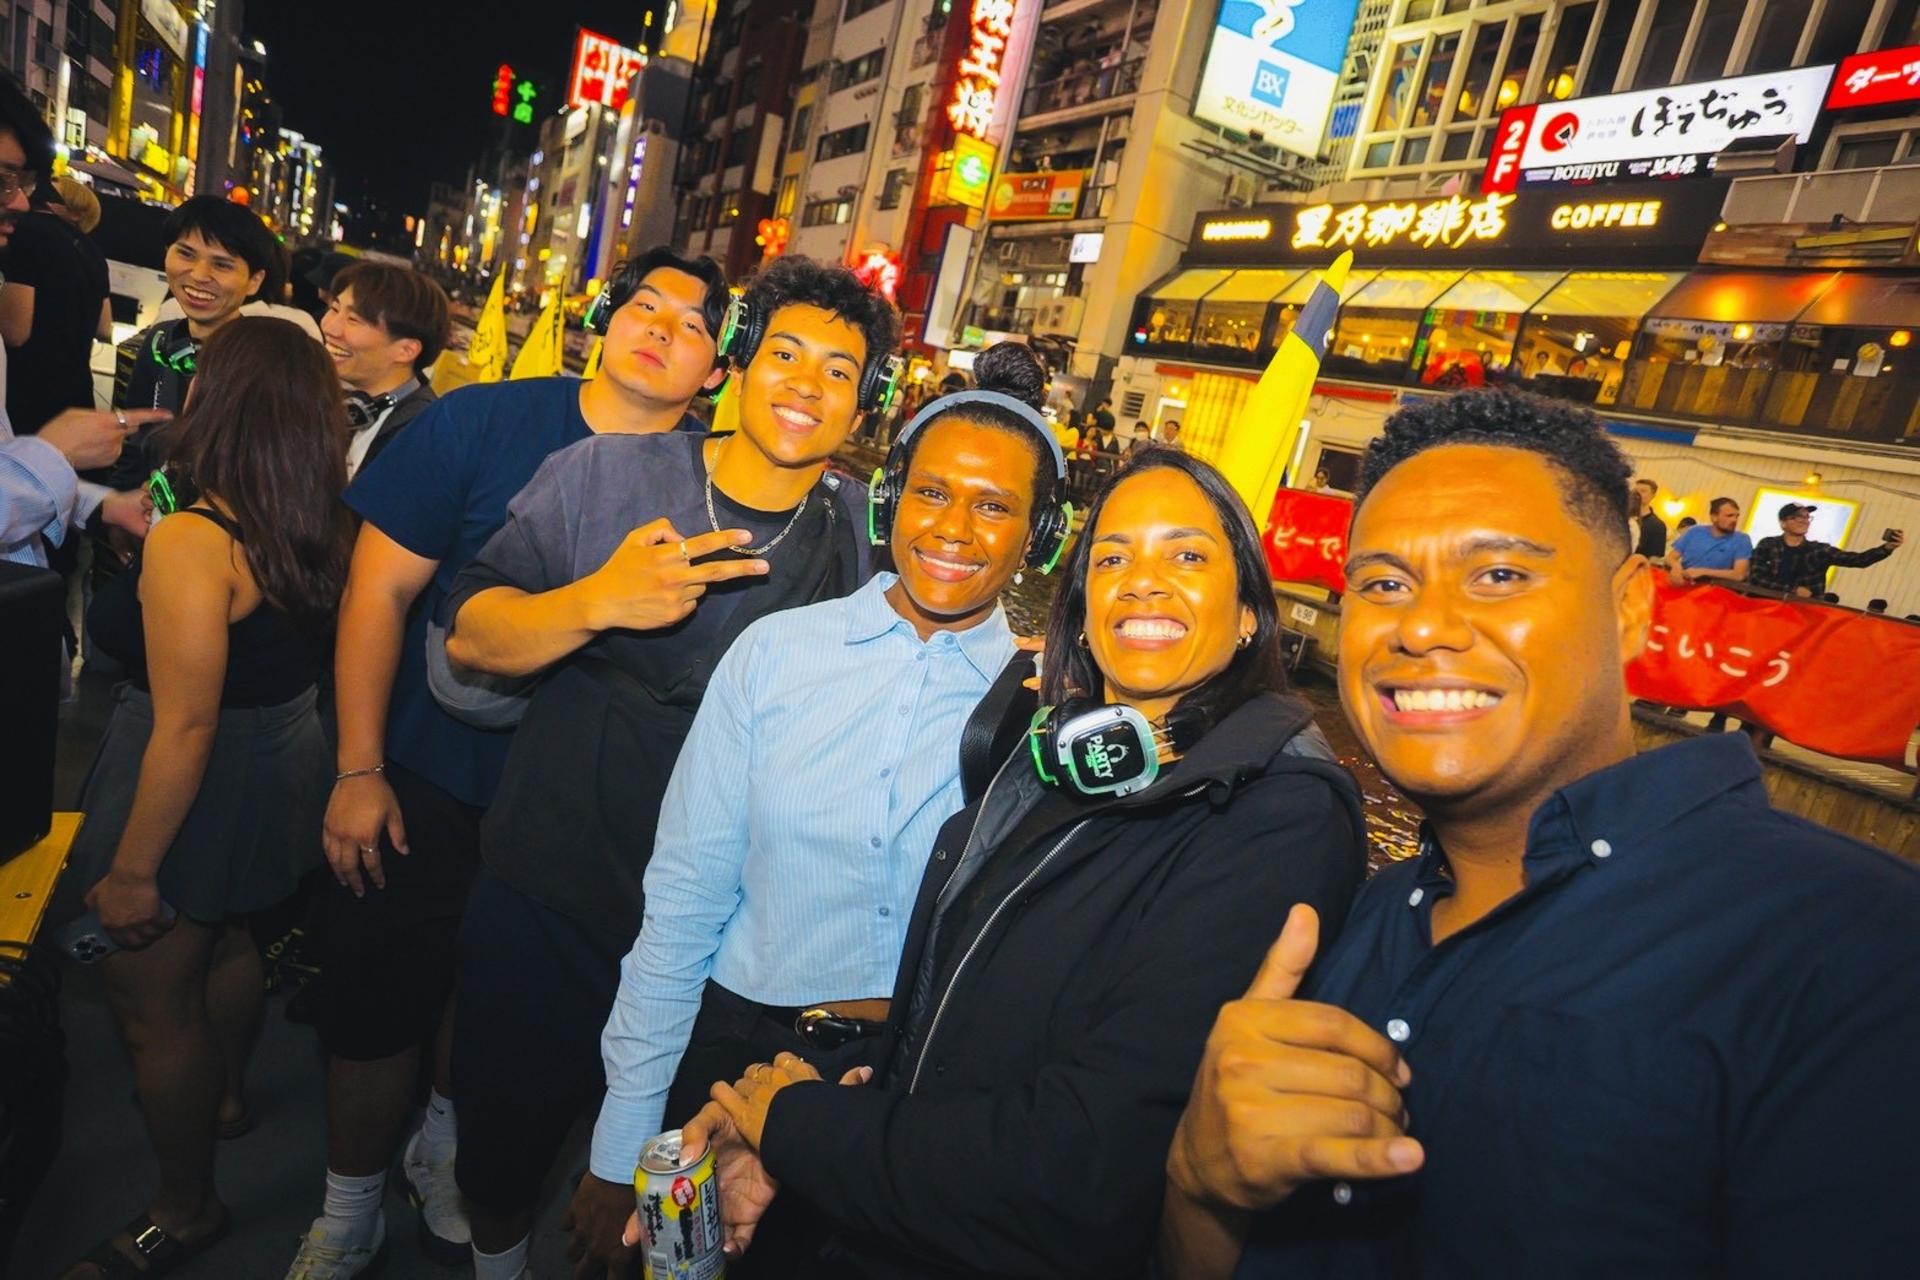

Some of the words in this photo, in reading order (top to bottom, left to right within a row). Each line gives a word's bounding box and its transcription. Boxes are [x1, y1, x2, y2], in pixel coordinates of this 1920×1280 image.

[1256, 69, 1285, 99] BX
[1493, 120, 1525, 183] 2F
[1552, 161, 1619, 181] BOTEJYU
[1551, 201, 1662, 230] COFFEE
[1089, 734, 1114, 778] PARTY
